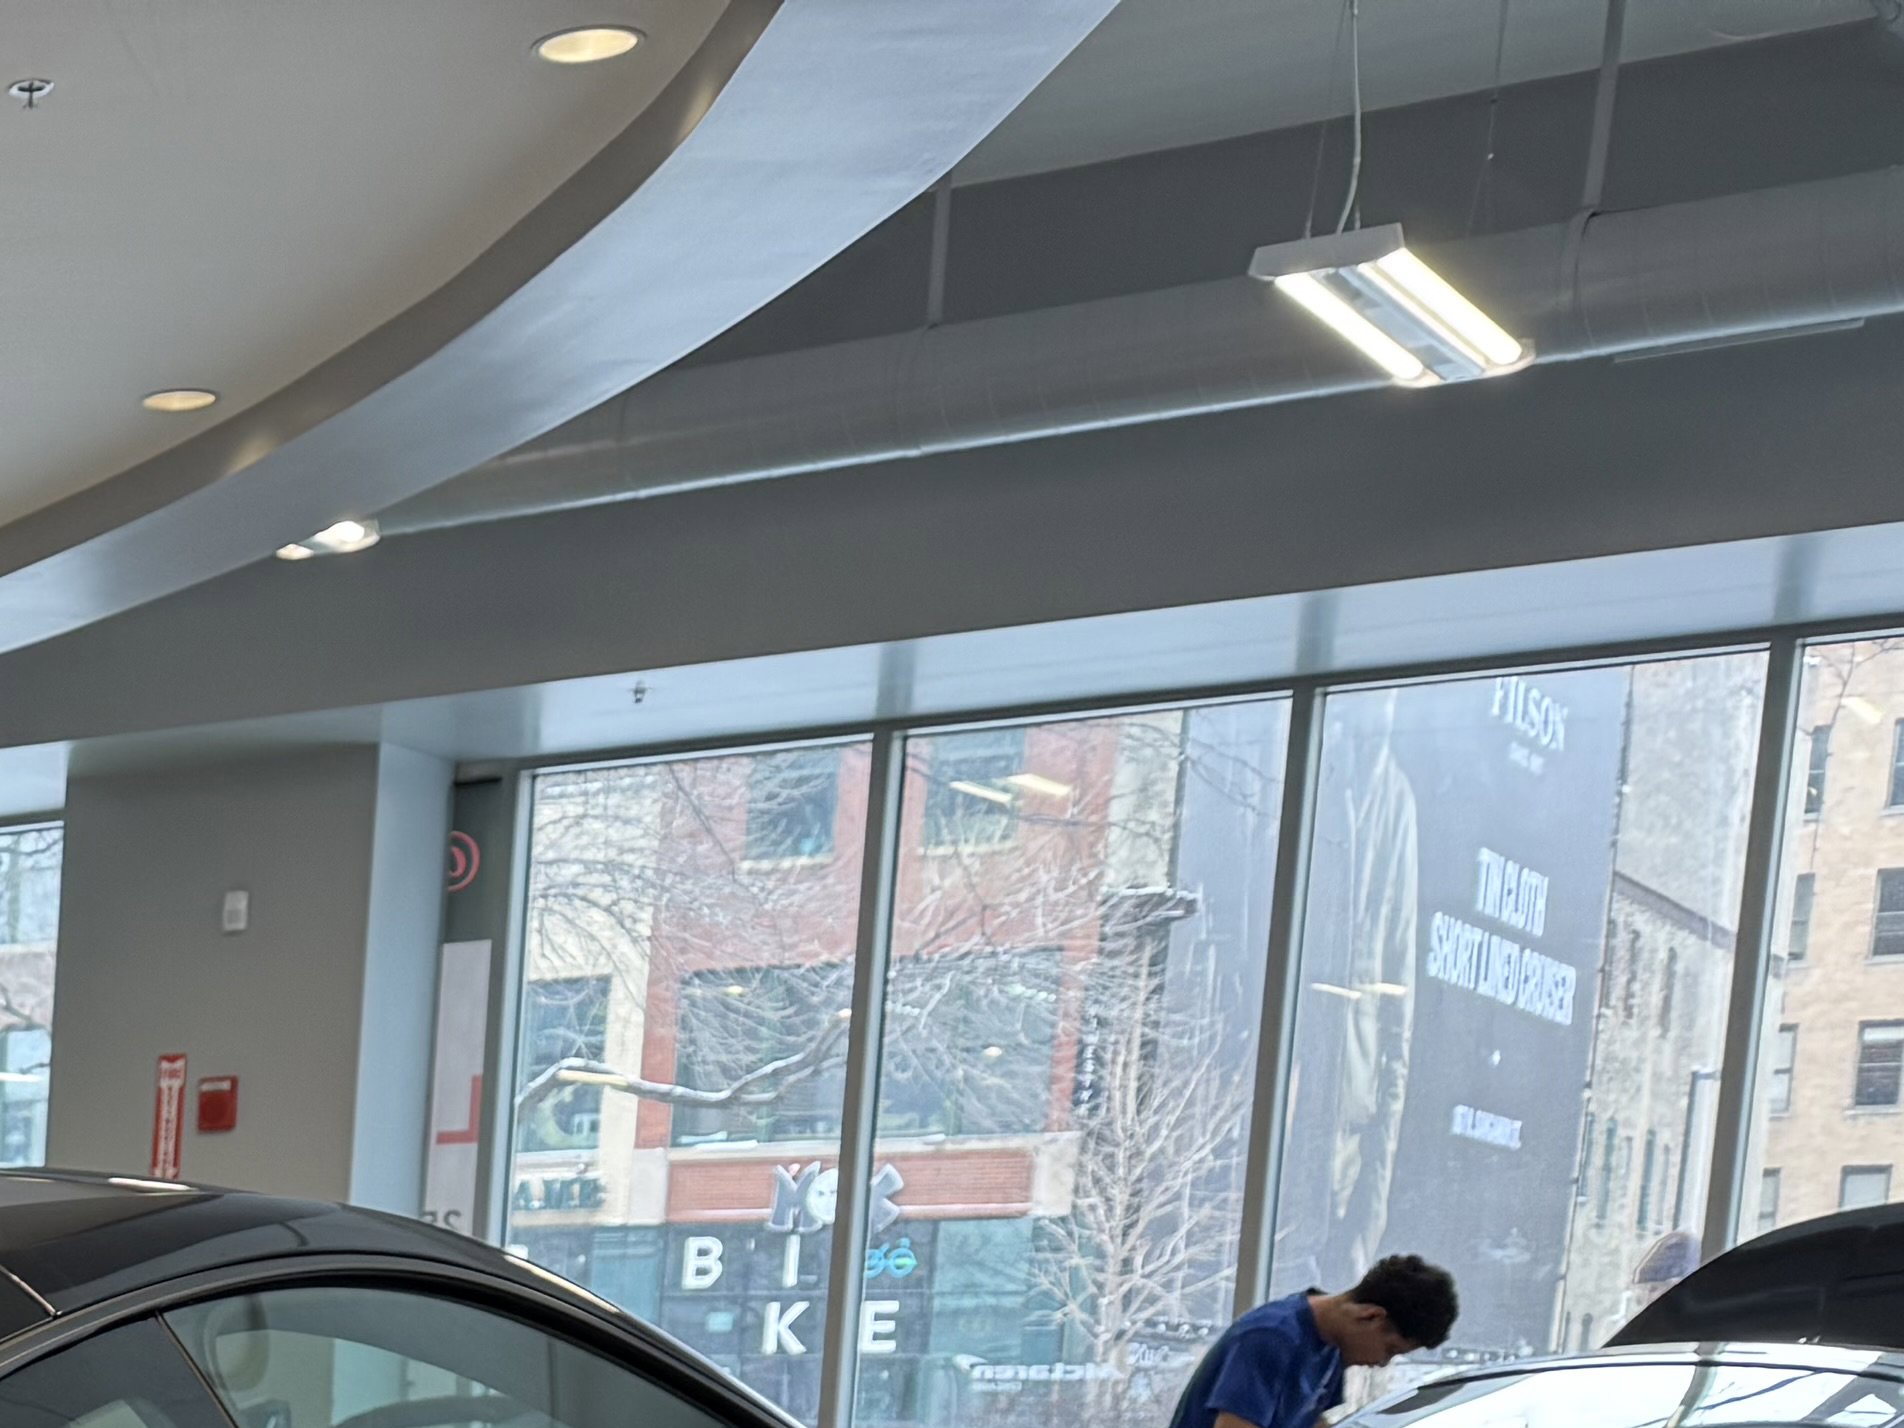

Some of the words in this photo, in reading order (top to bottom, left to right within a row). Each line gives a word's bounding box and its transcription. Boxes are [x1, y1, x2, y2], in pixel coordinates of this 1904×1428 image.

[1491, 676, 1568, 751] FILSON
[1476, 847, 1505, 918] TIN
[1500, 860, 1549, 937] CLOTH
[1427, 911, 1484, 990] SHORT
[1477, 932, 1520, 1004] LINED
